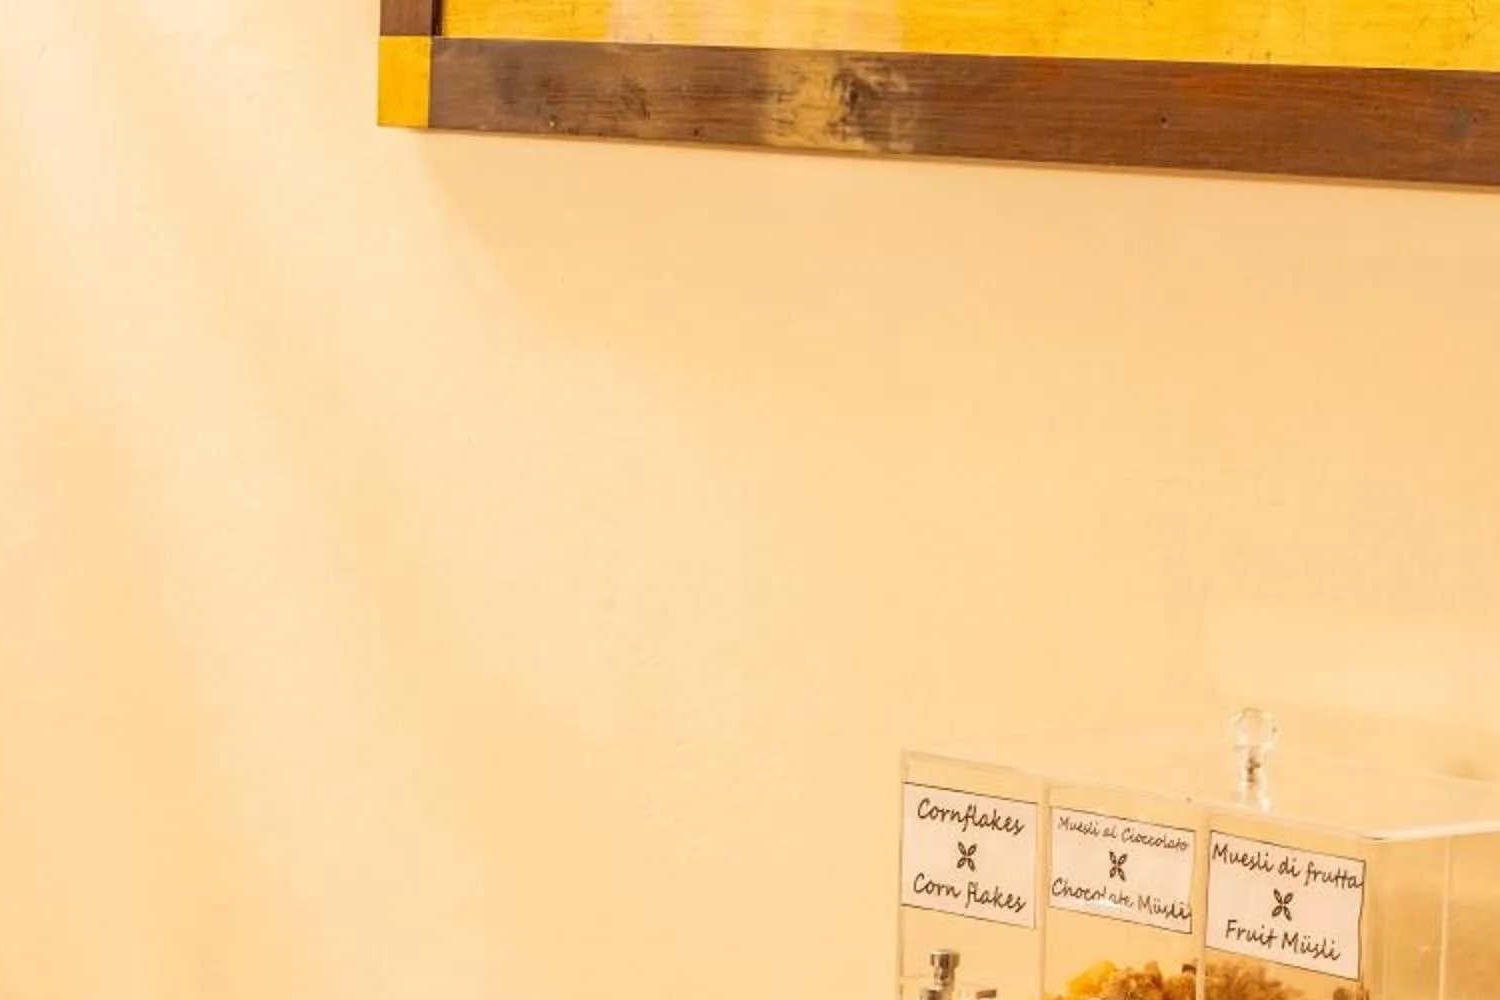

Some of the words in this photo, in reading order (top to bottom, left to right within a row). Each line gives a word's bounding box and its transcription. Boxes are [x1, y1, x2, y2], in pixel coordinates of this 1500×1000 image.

[917, 798, 1025, 835] Cornflakes
[1058, 816, 1101, 838] Muesli
[1122, 827, 1189, 850] Cioccolato
[1212, 843, 1274, 873] Muesli
[1278, 858, 1299, 878] di
[1304, 863, 1363, 889] frutta
[913, 873, 961, 898] Corn
[965, 881, 1026, 913] flakes
[1051, 878, 1134, 907] Chocolate
[1138, 896, 1192, 919] Müsli
[1226, 919, 1278, 947] Fruit
[1281, 932, 1341, 959] Müsli
